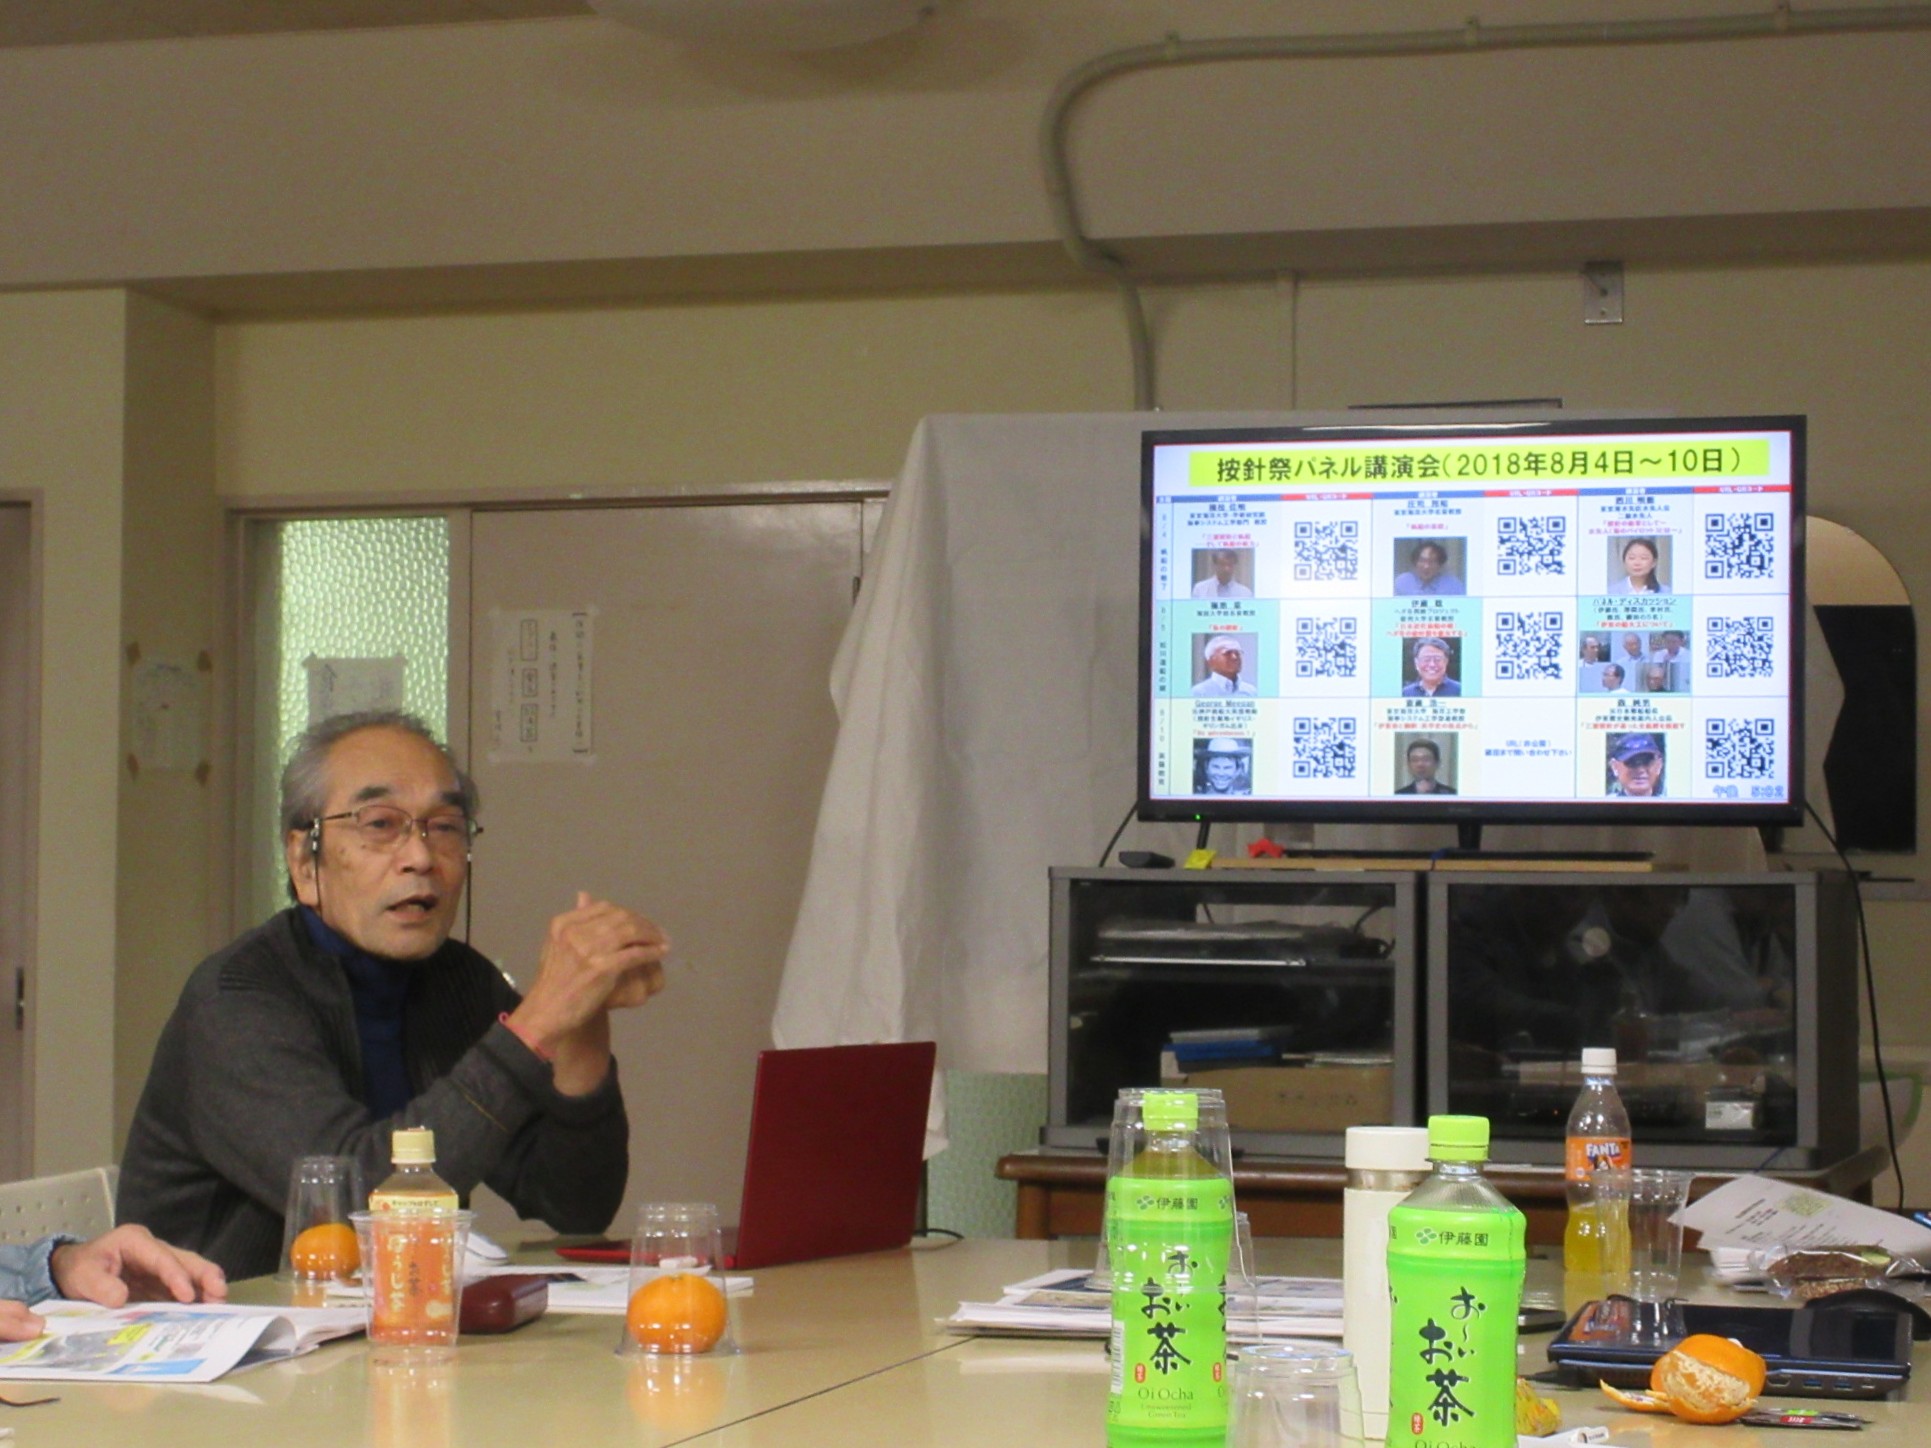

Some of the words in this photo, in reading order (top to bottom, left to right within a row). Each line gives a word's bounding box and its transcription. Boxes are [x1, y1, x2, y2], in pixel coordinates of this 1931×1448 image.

[1157, 1197, 1198, 1210] 伊藤園
[1439, 1232, 1488, 1247] 伊藤園
[1138, 1387, 1154, 1401] Oi
[1157, 1387, 1194, 1401] Ocha
